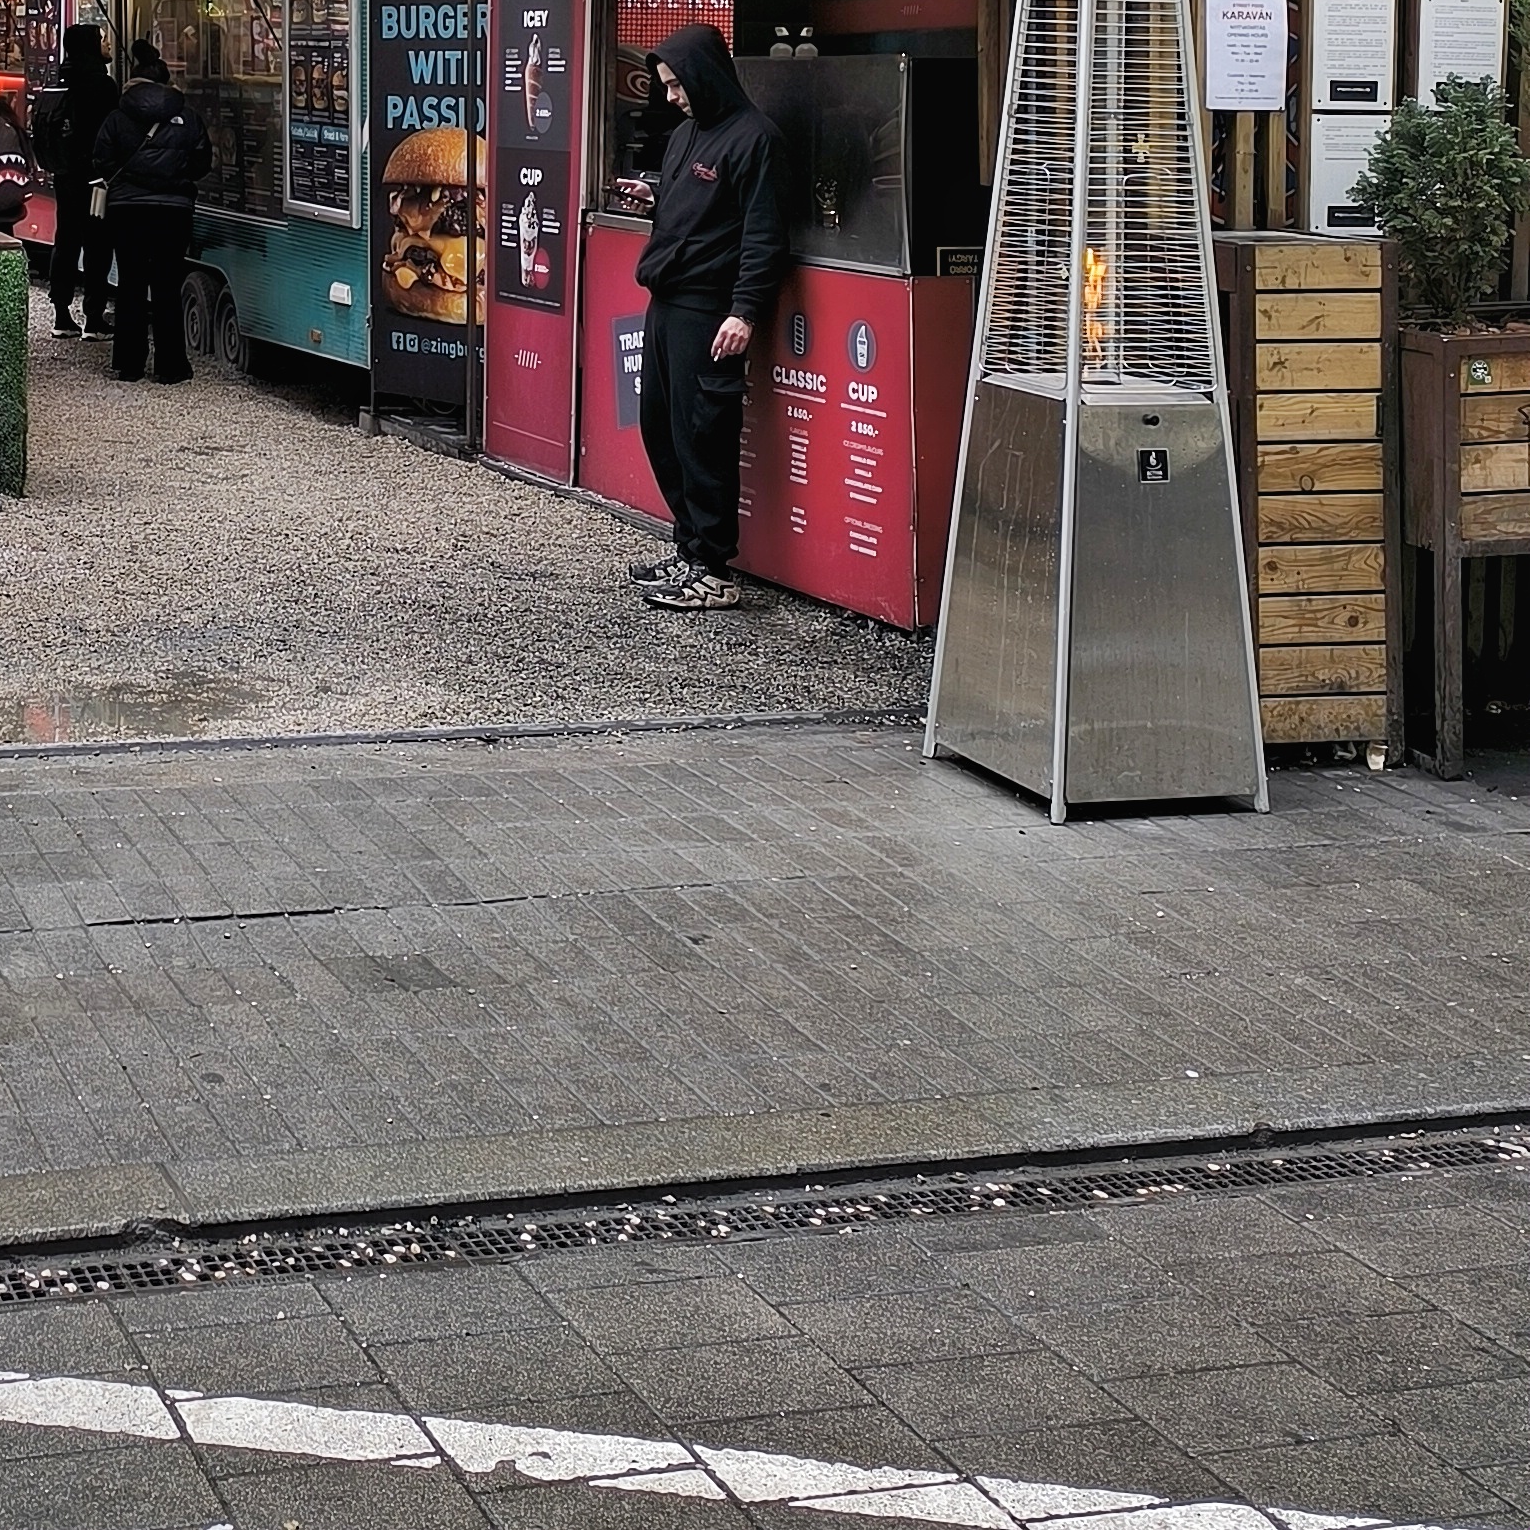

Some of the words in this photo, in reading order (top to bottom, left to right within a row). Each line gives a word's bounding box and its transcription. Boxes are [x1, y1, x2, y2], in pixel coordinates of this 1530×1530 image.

[381, 3, 490, 39] BURGER
[523, 10, 548, 28] ICEY
[1222, 10, 1273, 21] KARAVÁN
[519, 167, 543, 186] CUP
[772, 365, 827, 393] CLASSIC
[848, 381, 878, 403] CUP
